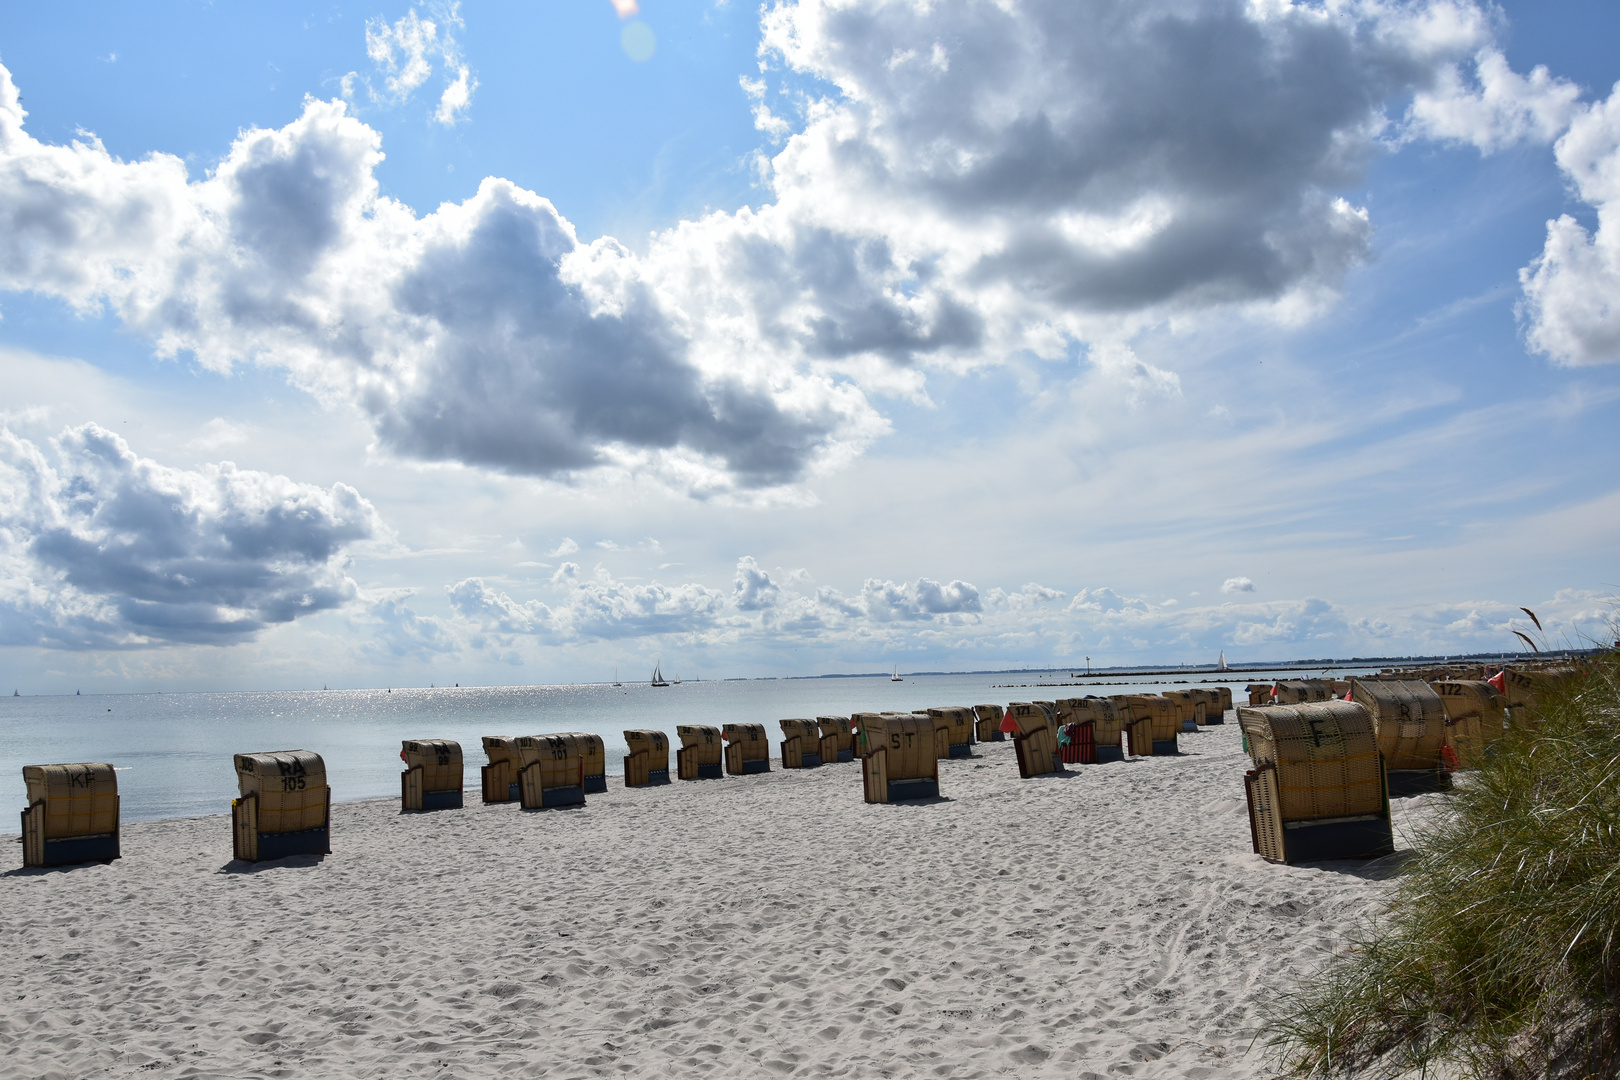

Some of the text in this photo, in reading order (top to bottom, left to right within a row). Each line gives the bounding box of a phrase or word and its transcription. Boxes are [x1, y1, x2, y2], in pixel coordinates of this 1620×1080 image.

[1298, 688, 1308, 696] RA
[1440, 683, 1462, 695] 172
[1072, 699, 1088, 708] 280
[1016, 706, 1030, 716] 171
[1400, 704, 1411, 721] R
[1309, 720, 1324, 747] F
[409, 742, 418, 752] 99
[490, 738, 500, 748] 98
[520, 738, 532, 747] 101
[547, 736, 567, 748] RA
[433, 744, 450, 755] RA
[552, 749, 568, 760] 101
[240, 757, 254, 772] 105
[438, 756, 448, 766] 99
[278, 760, 306, 777] RA
[281, 776, 306, 791] 105
